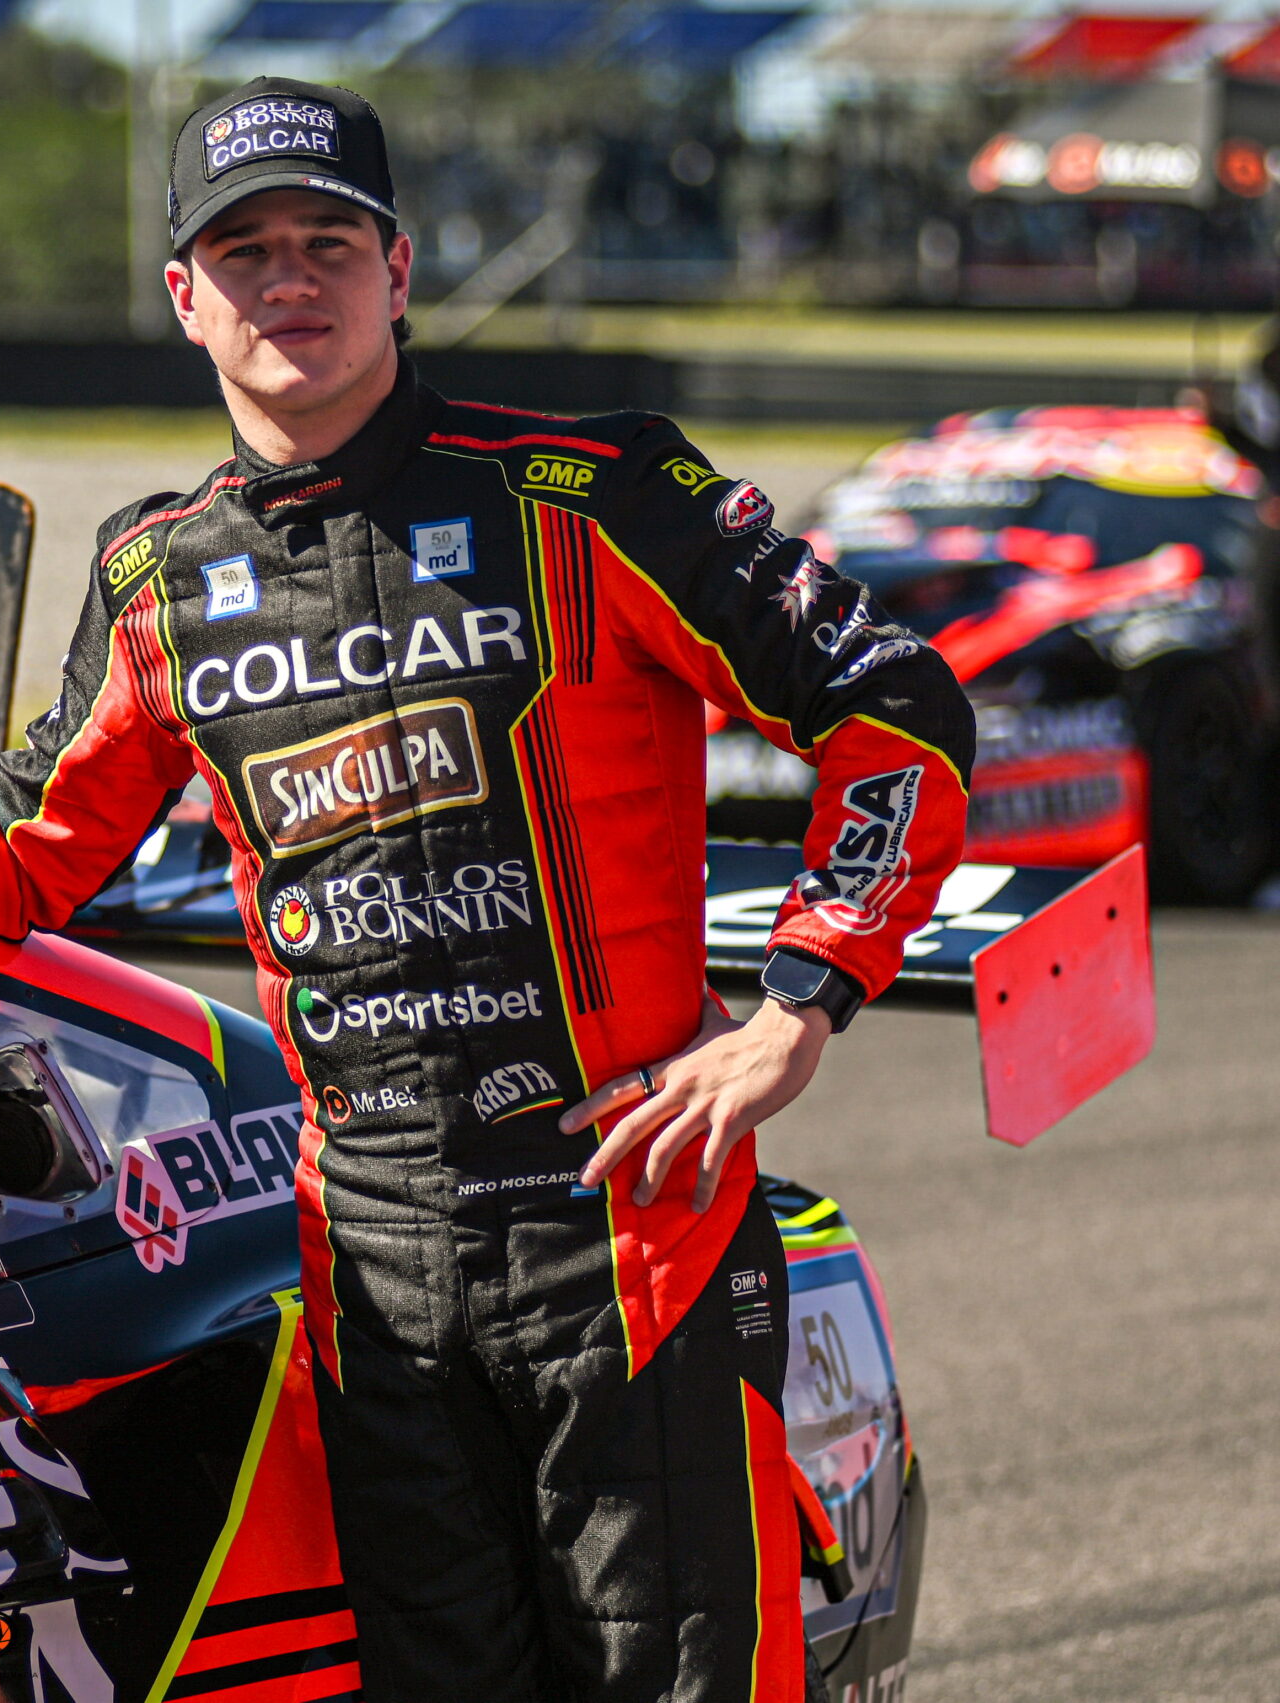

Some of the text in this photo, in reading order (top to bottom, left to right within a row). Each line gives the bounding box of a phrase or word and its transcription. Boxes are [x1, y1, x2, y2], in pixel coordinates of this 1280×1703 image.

[235, 102, 333, 120] POLLOS
[236, 111, 335, 131] BONNIN
[212, 130, 331, 167] COLCAR
[526, 460, 594, 488] OMP
[431, 530, 452, 546] 50
[108, 537, 153, 586] OMP
[429, 549, 458, 569] md
[221, 570, 238, 585] 50
[221, 589, 246, 607] md
[186, 606, 527, 717] COLCAR
[886, 769, 920, 864] LUBRICANTES
[324, 860, 528, 908] POLLOS
[328, 888, 533, 947] BONNIN
[343, 981, 542, 1038] Sportsbet
[473, 1061, 558, 1122] RASTA
[458, 1171, 579, 1196] NICO MOSCARD
[731, 1274, 756, 1292] OMP
[800, 1310, 853, 1407] 50
